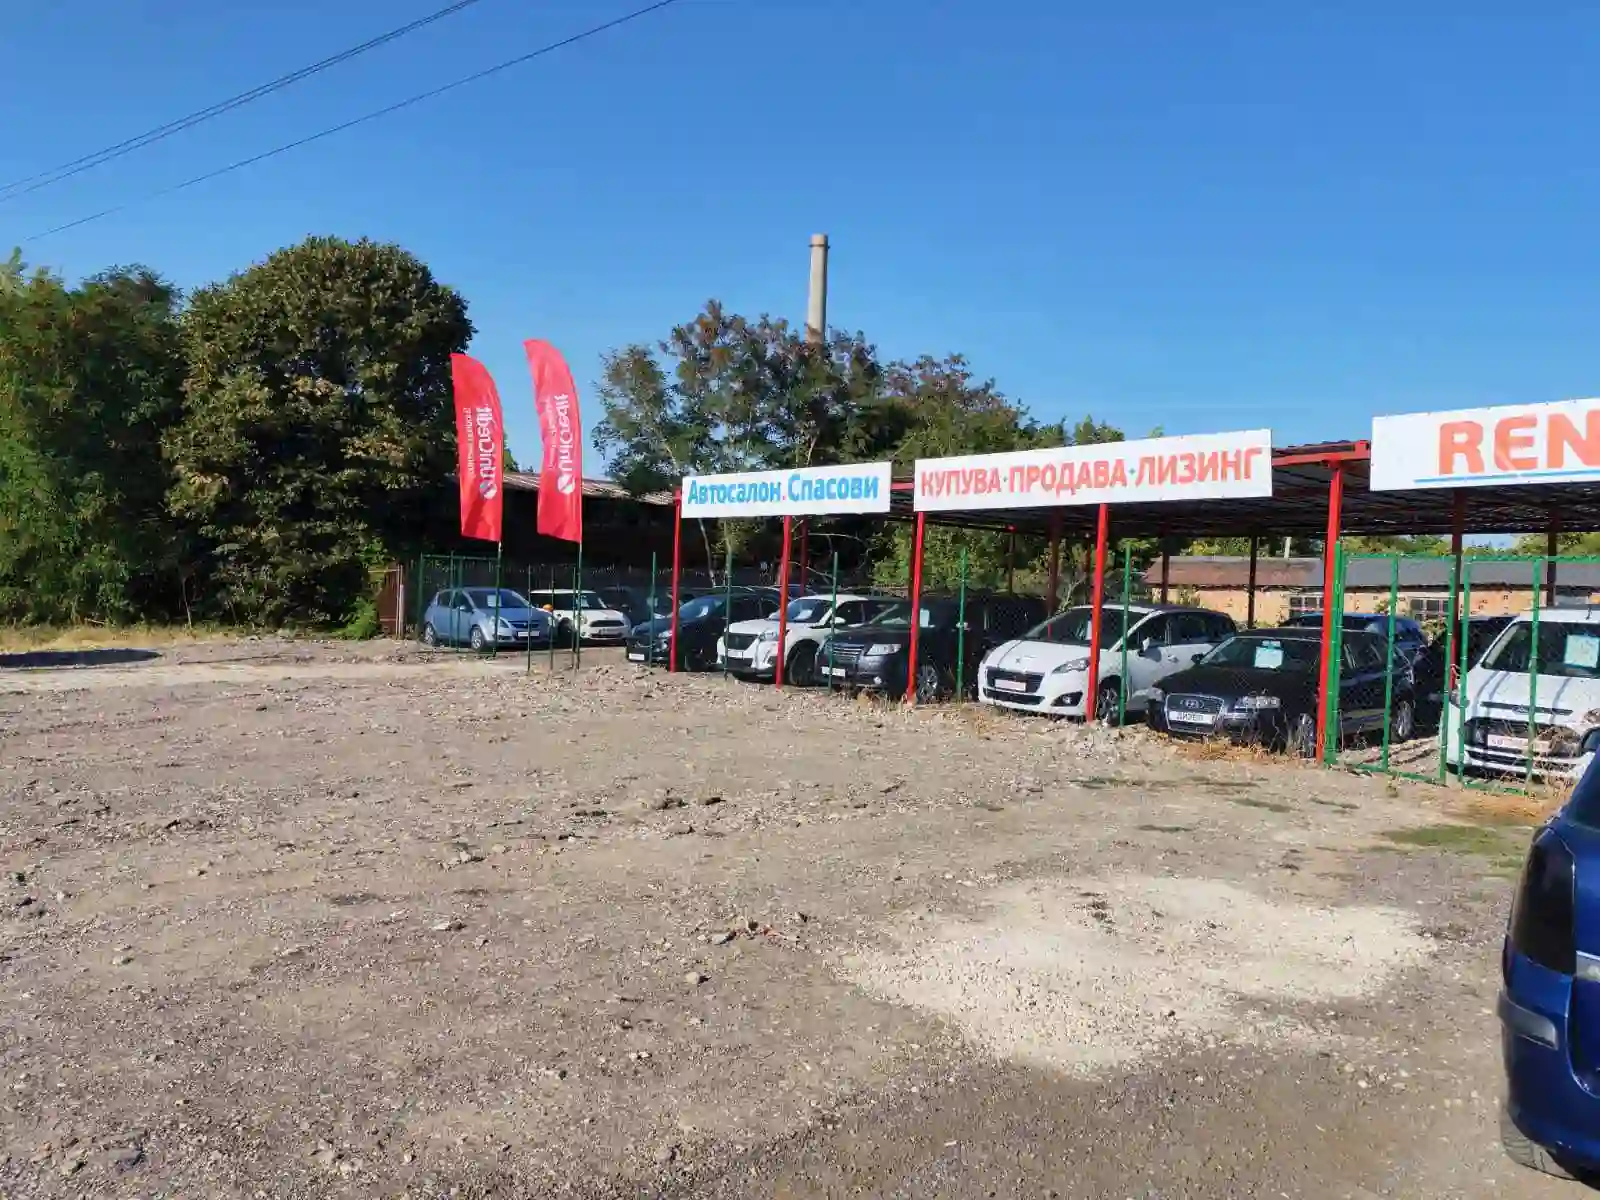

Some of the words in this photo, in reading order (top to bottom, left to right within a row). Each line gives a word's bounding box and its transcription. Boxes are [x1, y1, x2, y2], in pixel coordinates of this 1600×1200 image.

[1439, 409, 1600, 476] REN
[687, 480, 781, 505] Автосалон
[787, 473, 879, 501] Спасови
[920, 467, 1001, 498] КУПУВА
[1009, 458, 1129, 498] ПРОДАВА
[1136, 447, 1263, 486] ЛИЗИНГ
